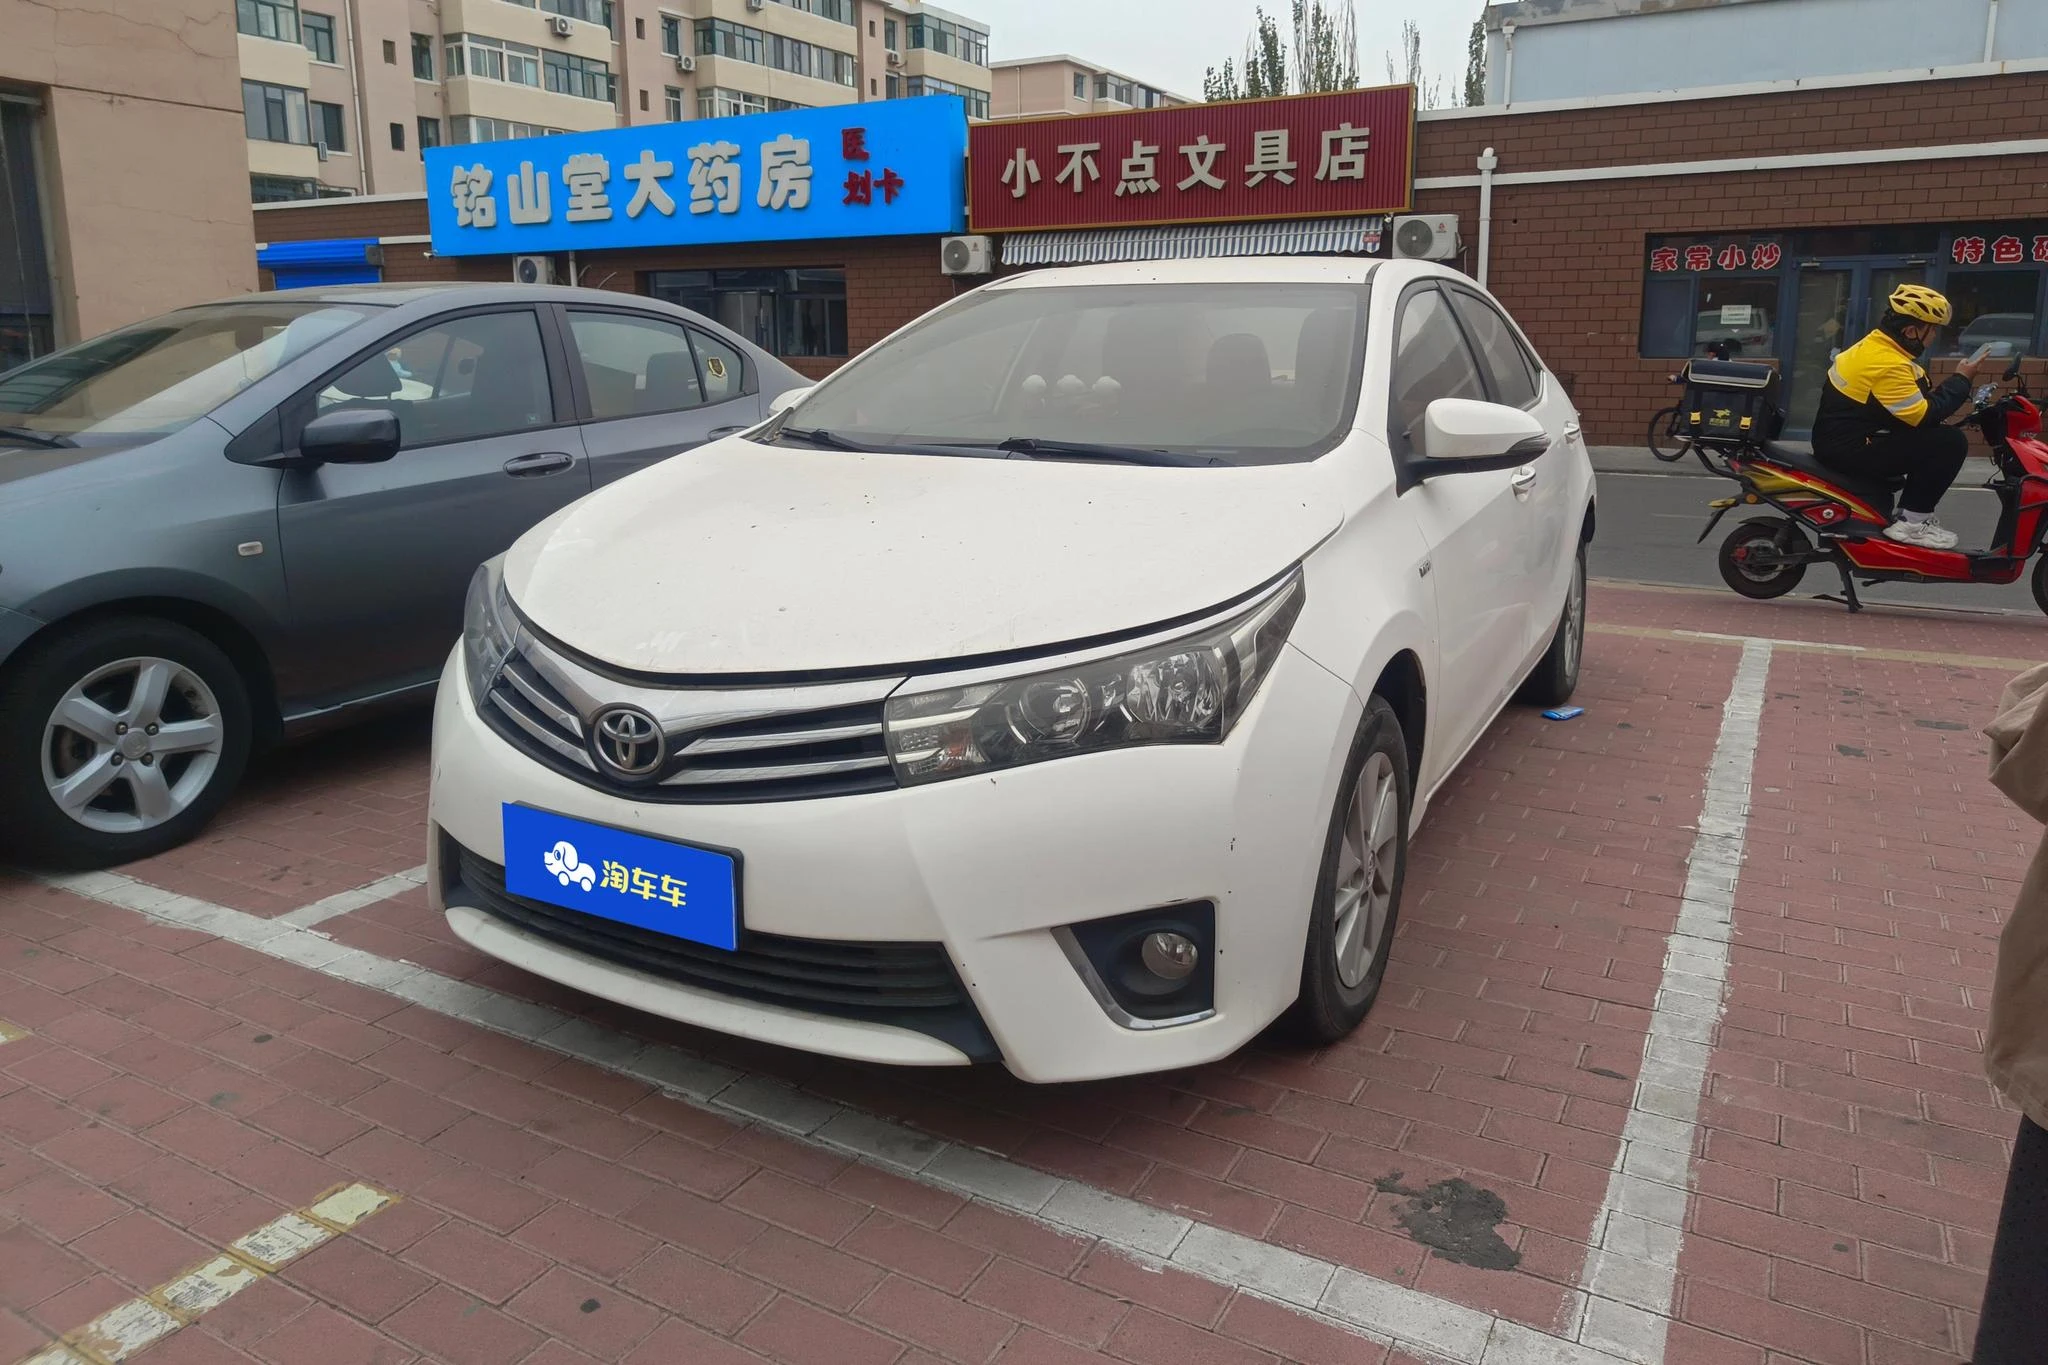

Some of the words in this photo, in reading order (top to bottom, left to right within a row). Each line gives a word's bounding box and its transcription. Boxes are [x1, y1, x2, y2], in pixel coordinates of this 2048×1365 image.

[841, 127, 870, 160] 医
[1001, 122, 1370, 198] 小不点文具店
[451, 134, 813, 228] 铭山堂大药房
[843, 168, 904, 205] 划卡
[1651, 243, 1781, 271] 家常小炒
